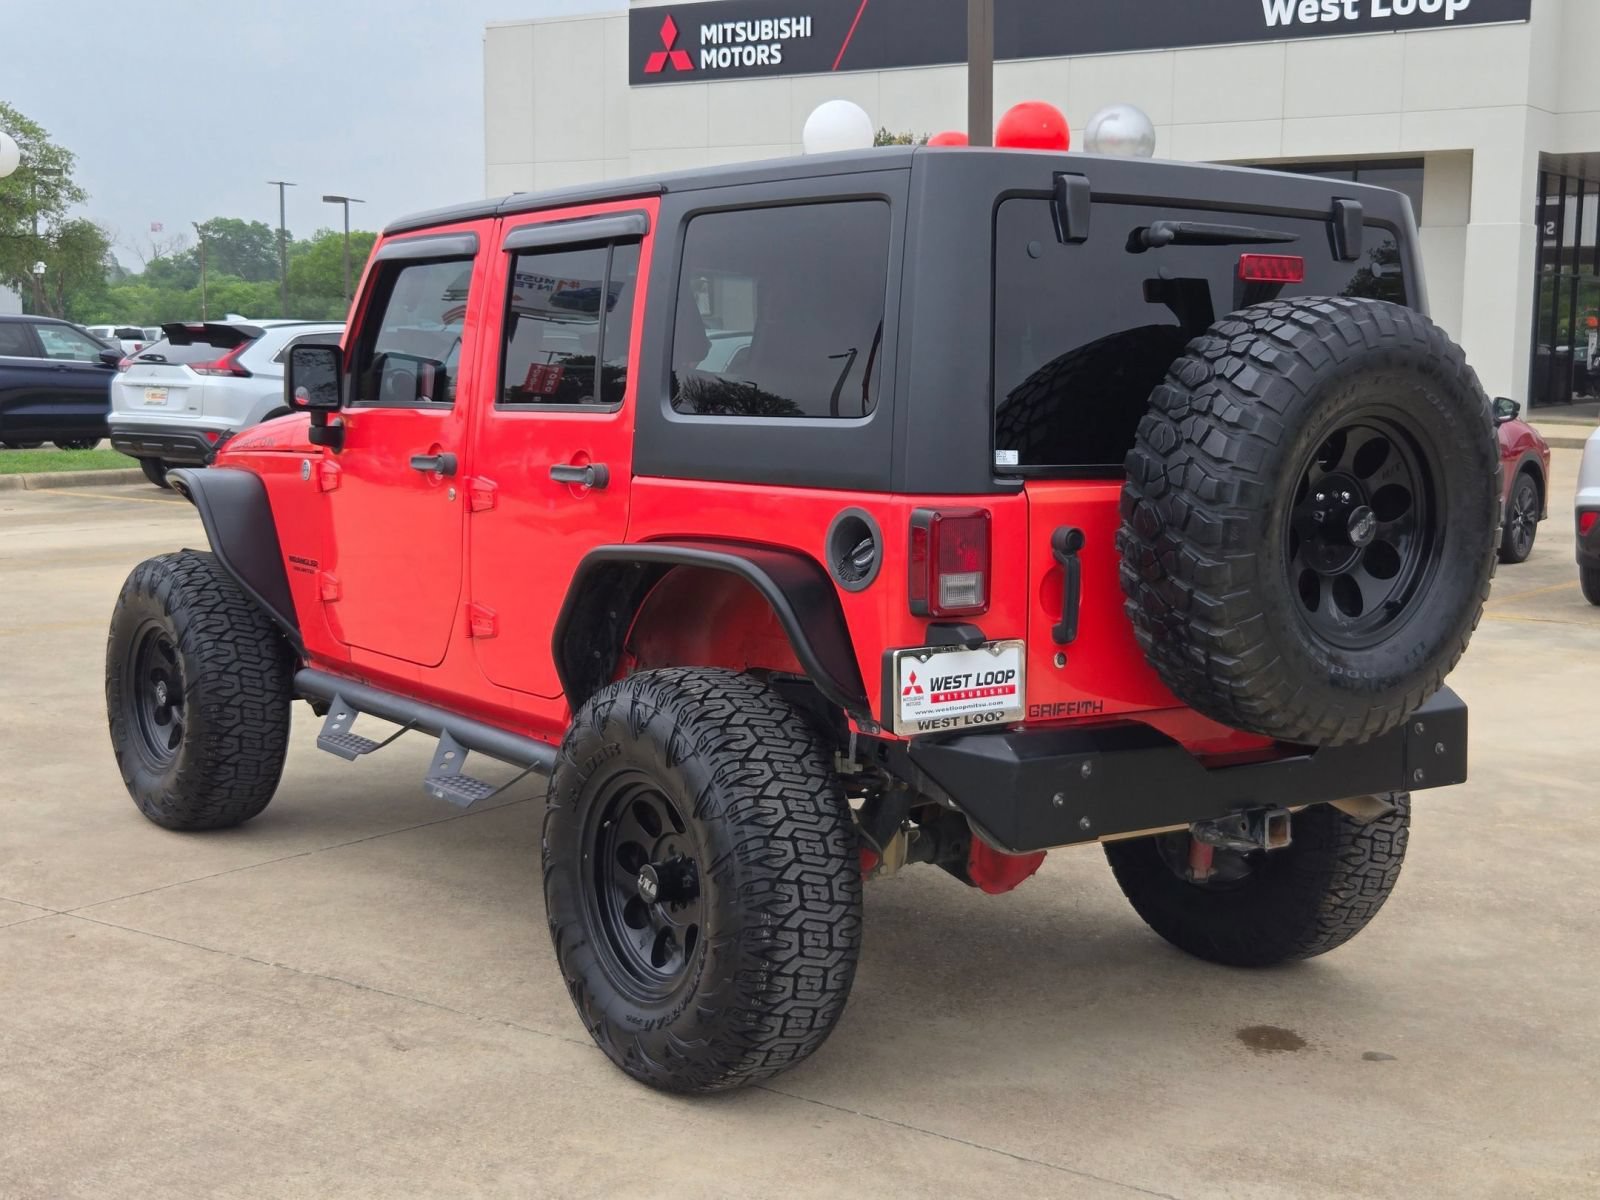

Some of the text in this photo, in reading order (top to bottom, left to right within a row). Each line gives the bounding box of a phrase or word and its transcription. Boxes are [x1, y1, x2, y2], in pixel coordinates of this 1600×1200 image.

[1262, 0, 1470, 27] West Loop
[700, 16, 812, 46] MITSUBISHI
[700, 43, 783, 70] MOTORS
[930, 669, 1016, 692] WEST LOOP
[939, 687, 1011, 701] MITSUBISHI
[915, 700, 1004, 716] www.westloopmitsu.com
[1028, 700, 1104, 718] GRIFFITH
[918, 711, 1005, 731] WEST LOOP
